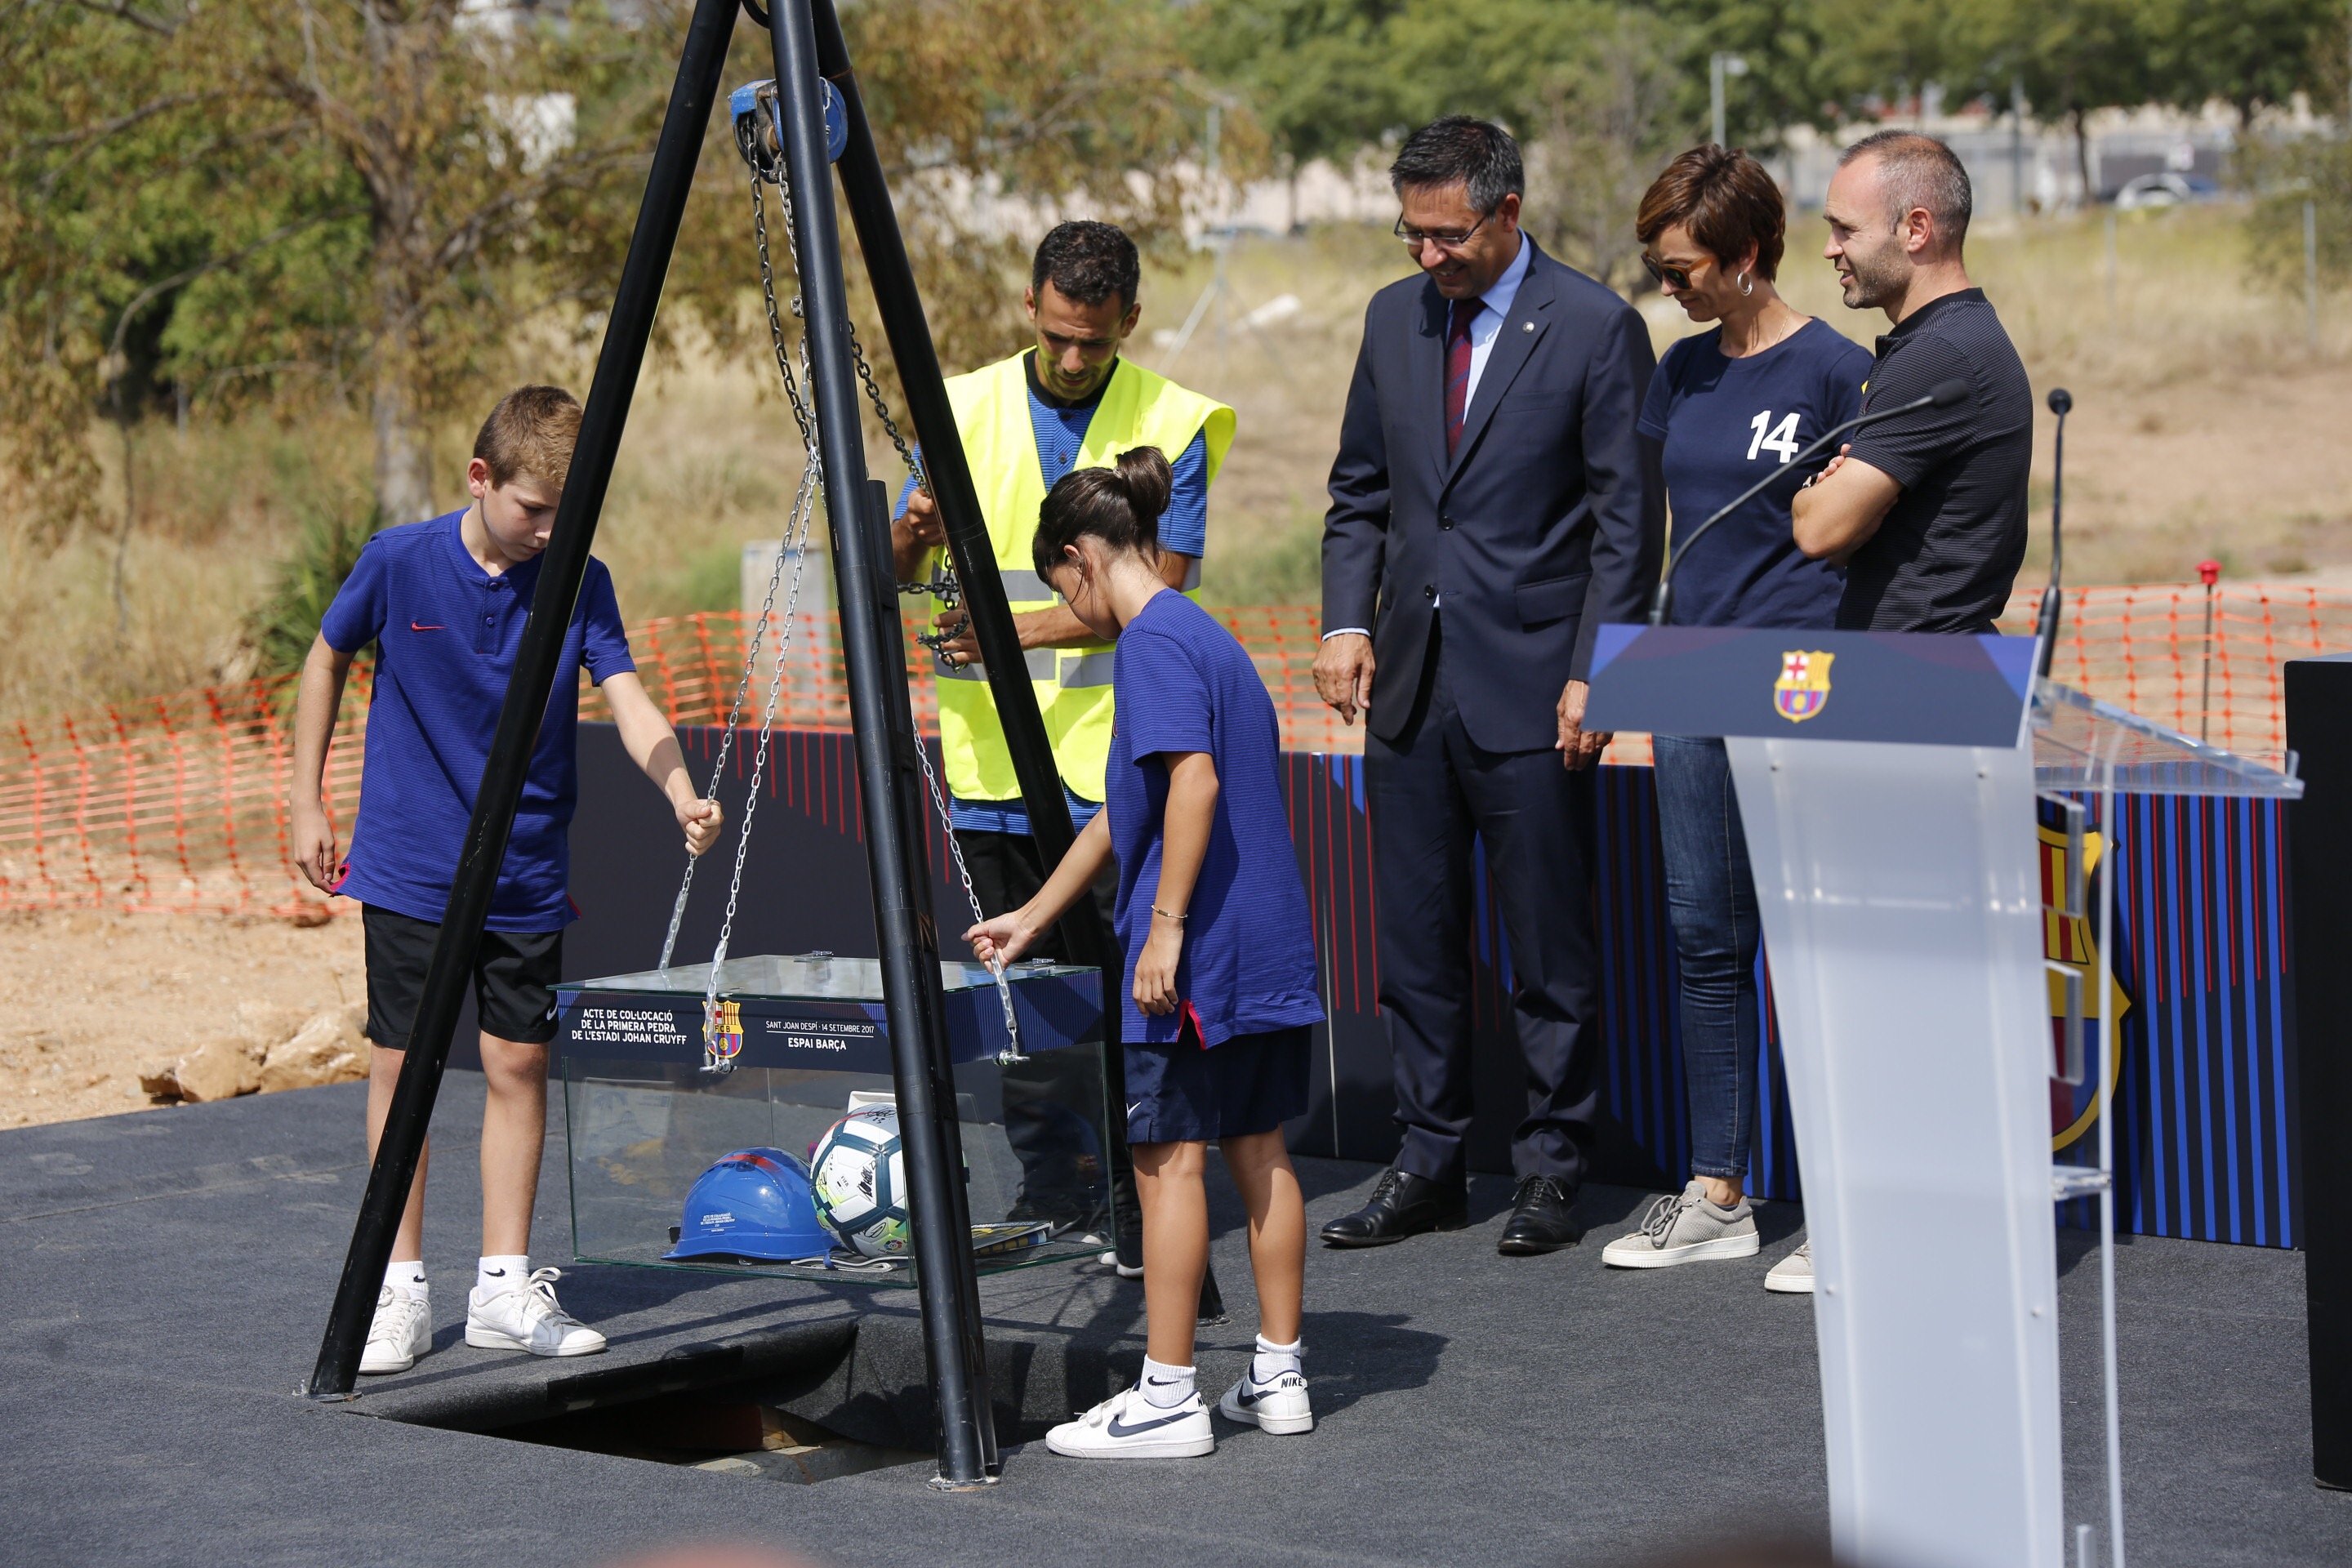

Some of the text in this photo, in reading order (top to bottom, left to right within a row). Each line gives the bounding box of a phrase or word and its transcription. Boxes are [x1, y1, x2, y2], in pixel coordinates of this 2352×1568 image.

[1746, 409, 1801, 464] 14
[582, 1009, 673, 1022] ACTE DE COL·LOCACIÓ
[581, 1019, 676, 1033] DE LA PRIMERA PEDRA
[765, 1020, 875, 1034] SANT JOAN DESPÍ 14 SETEMBRE 2017
[572, 1030, 687, 1045] DE L'ESTADI JOHAN CRUYFF
[788, 1037, 847, 1052] ESPAI BARÇA
[1281, 1377, 1303, 1388] NIKE
